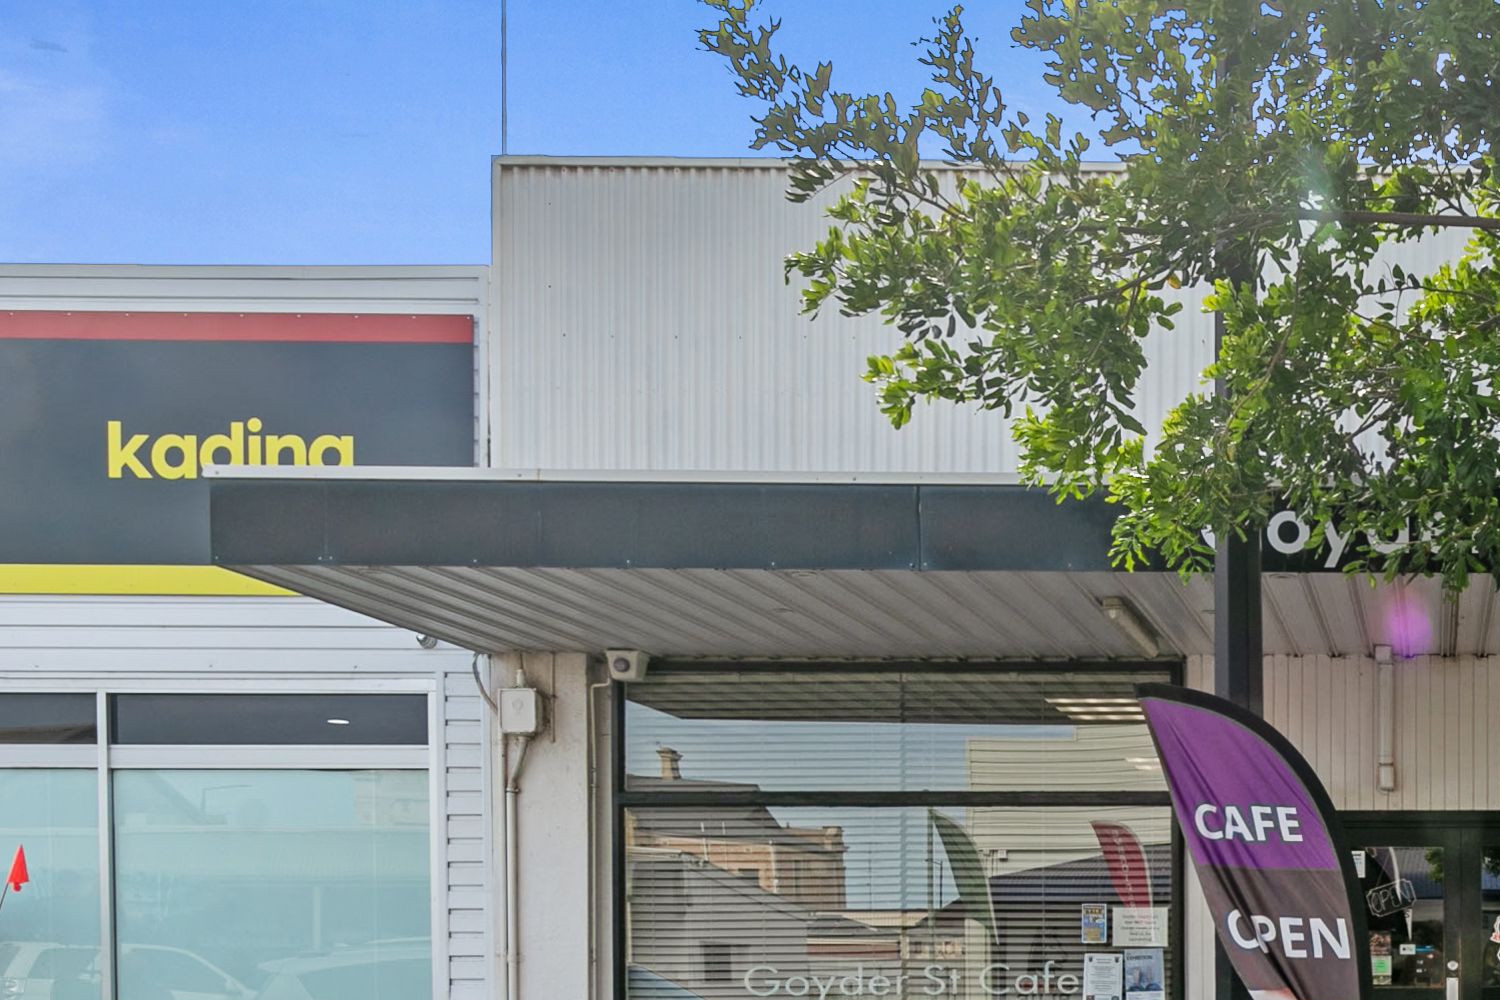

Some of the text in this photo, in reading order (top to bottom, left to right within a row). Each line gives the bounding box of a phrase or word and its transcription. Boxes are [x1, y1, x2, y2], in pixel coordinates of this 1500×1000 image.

[1194, 803, 1304, 842] CAFE
[1227, 909, 1351, 959] OPEN
[923, 963, 961, 996] St
[979, 961, 1080, 995] Cafe
